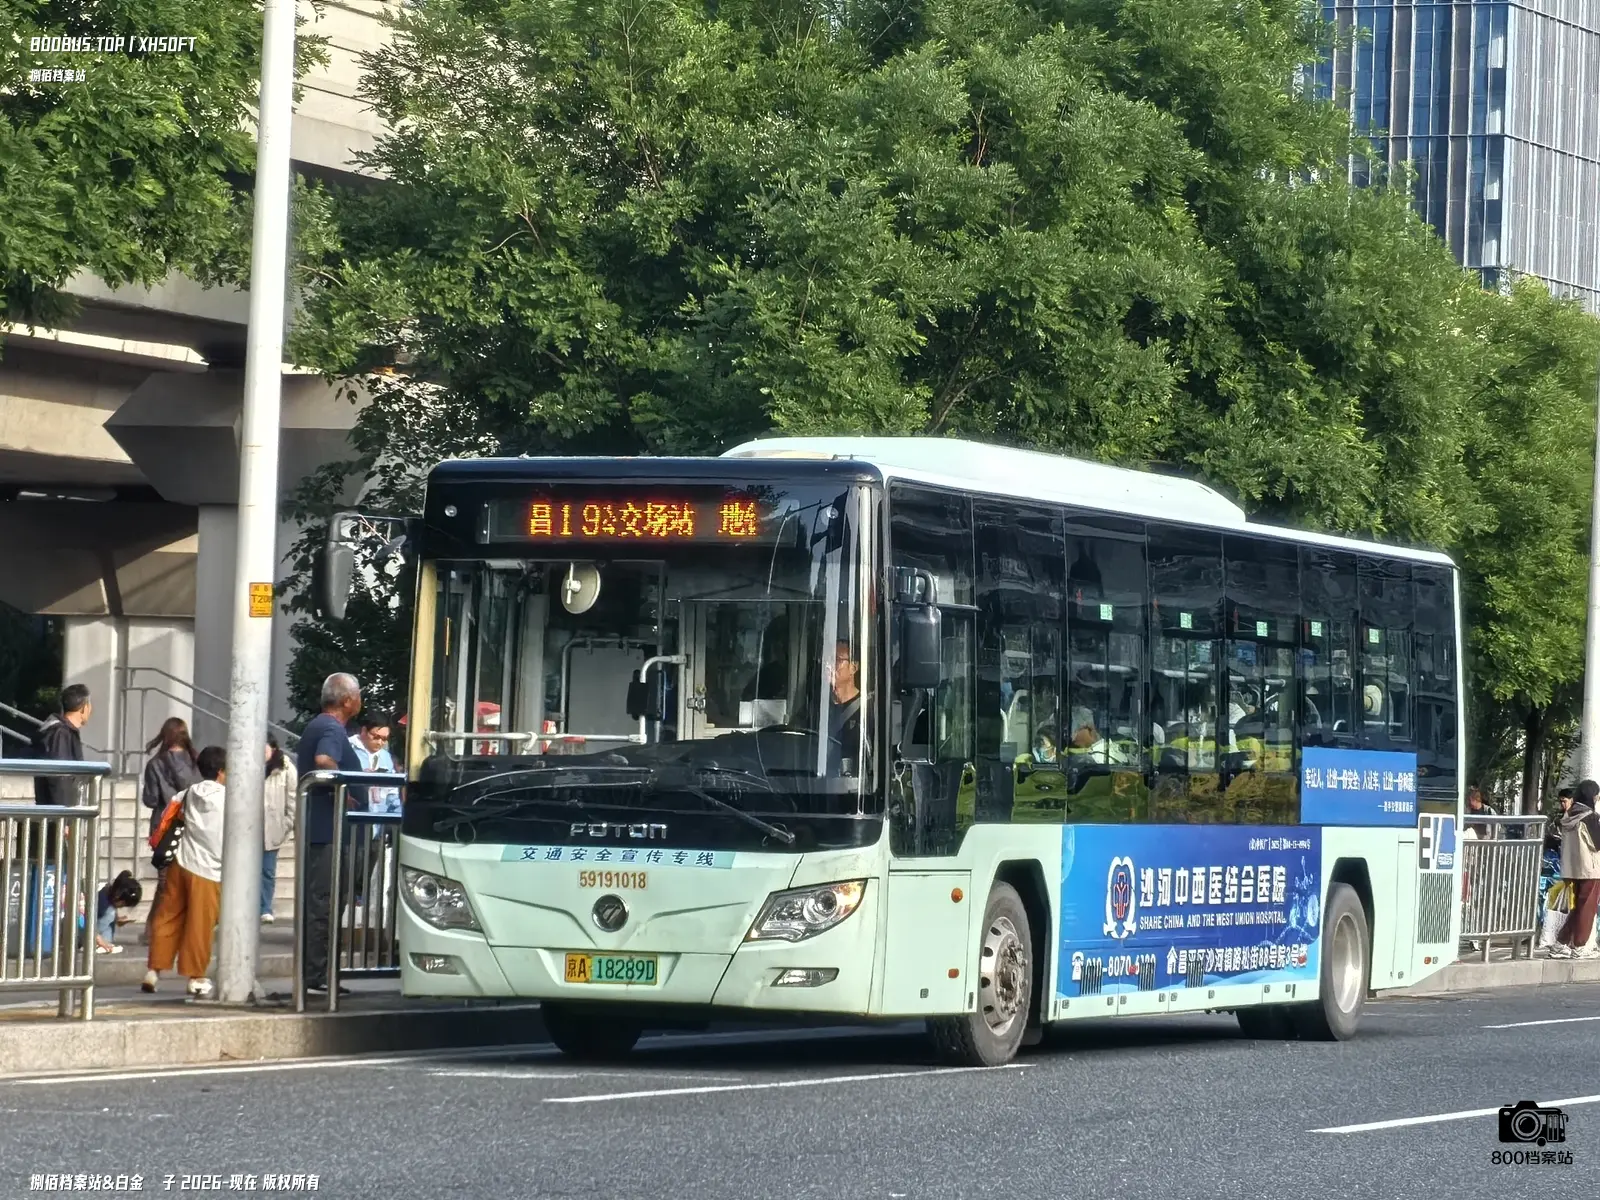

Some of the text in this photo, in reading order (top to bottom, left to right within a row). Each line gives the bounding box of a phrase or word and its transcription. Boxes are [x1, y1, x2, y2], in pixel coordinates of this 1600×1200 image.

[570, 822, 668, 839] FOTON
[519, 846, 715, 867] 交通安全宣传专线
[579, 870, 647, 889] 59191018
[1139, 865, 1287, 908] 沙河中西医结合医院
[1139, 910, 1287, 930] SHAHE CHINA AND THE WEST UNION HOSPITAL
